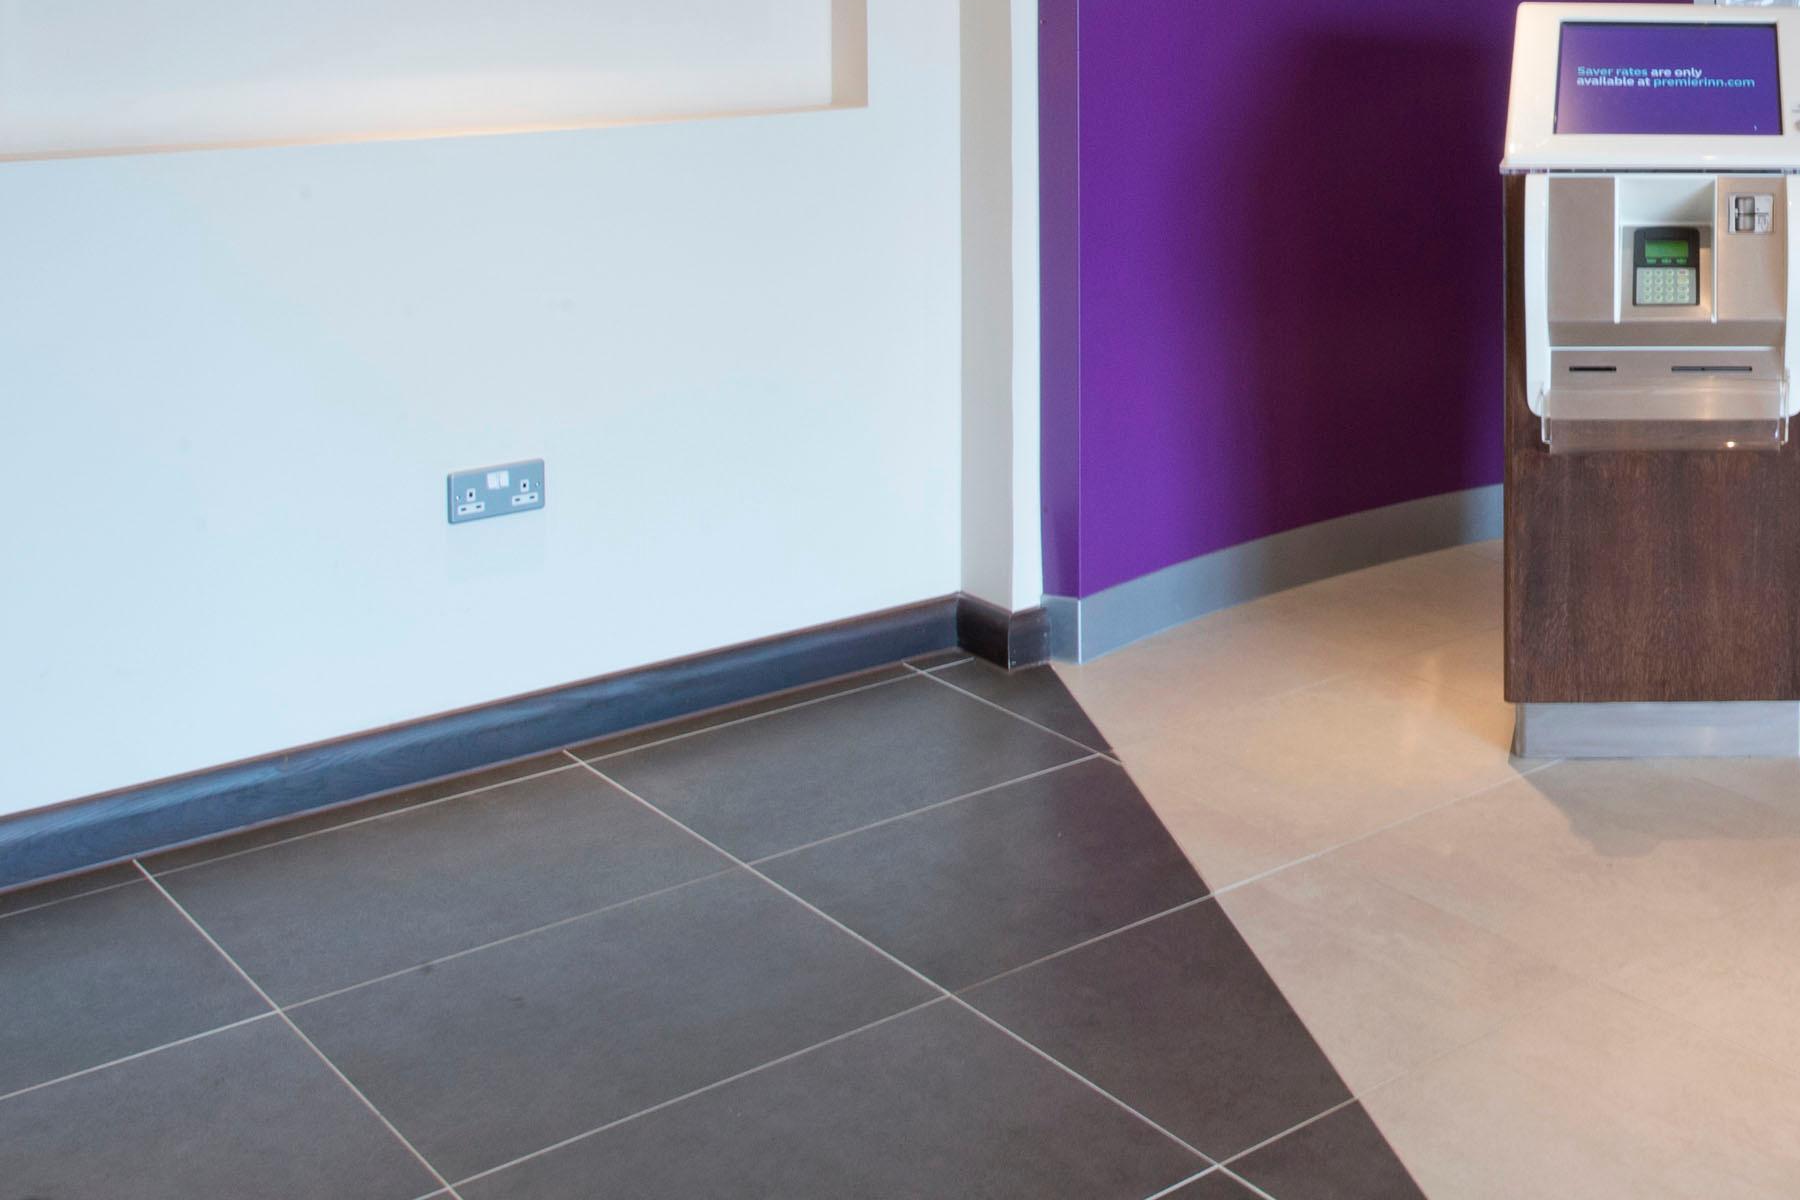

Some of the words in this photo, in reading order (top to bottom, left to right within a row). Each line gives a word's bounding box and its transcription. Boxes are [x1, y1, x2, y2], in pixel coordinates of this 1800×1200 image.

[1577, 66, 1614, 78] Saver
[1616, 67, 1648, 77] rates
[1650, 69, 1672, 78] are
[1674, 67, 1702, 80] only
[1577, 76, 1635, 87] available
[1637, 77, 1651, 87] at
[1653, 76, 1756, 89] premierinn.com
